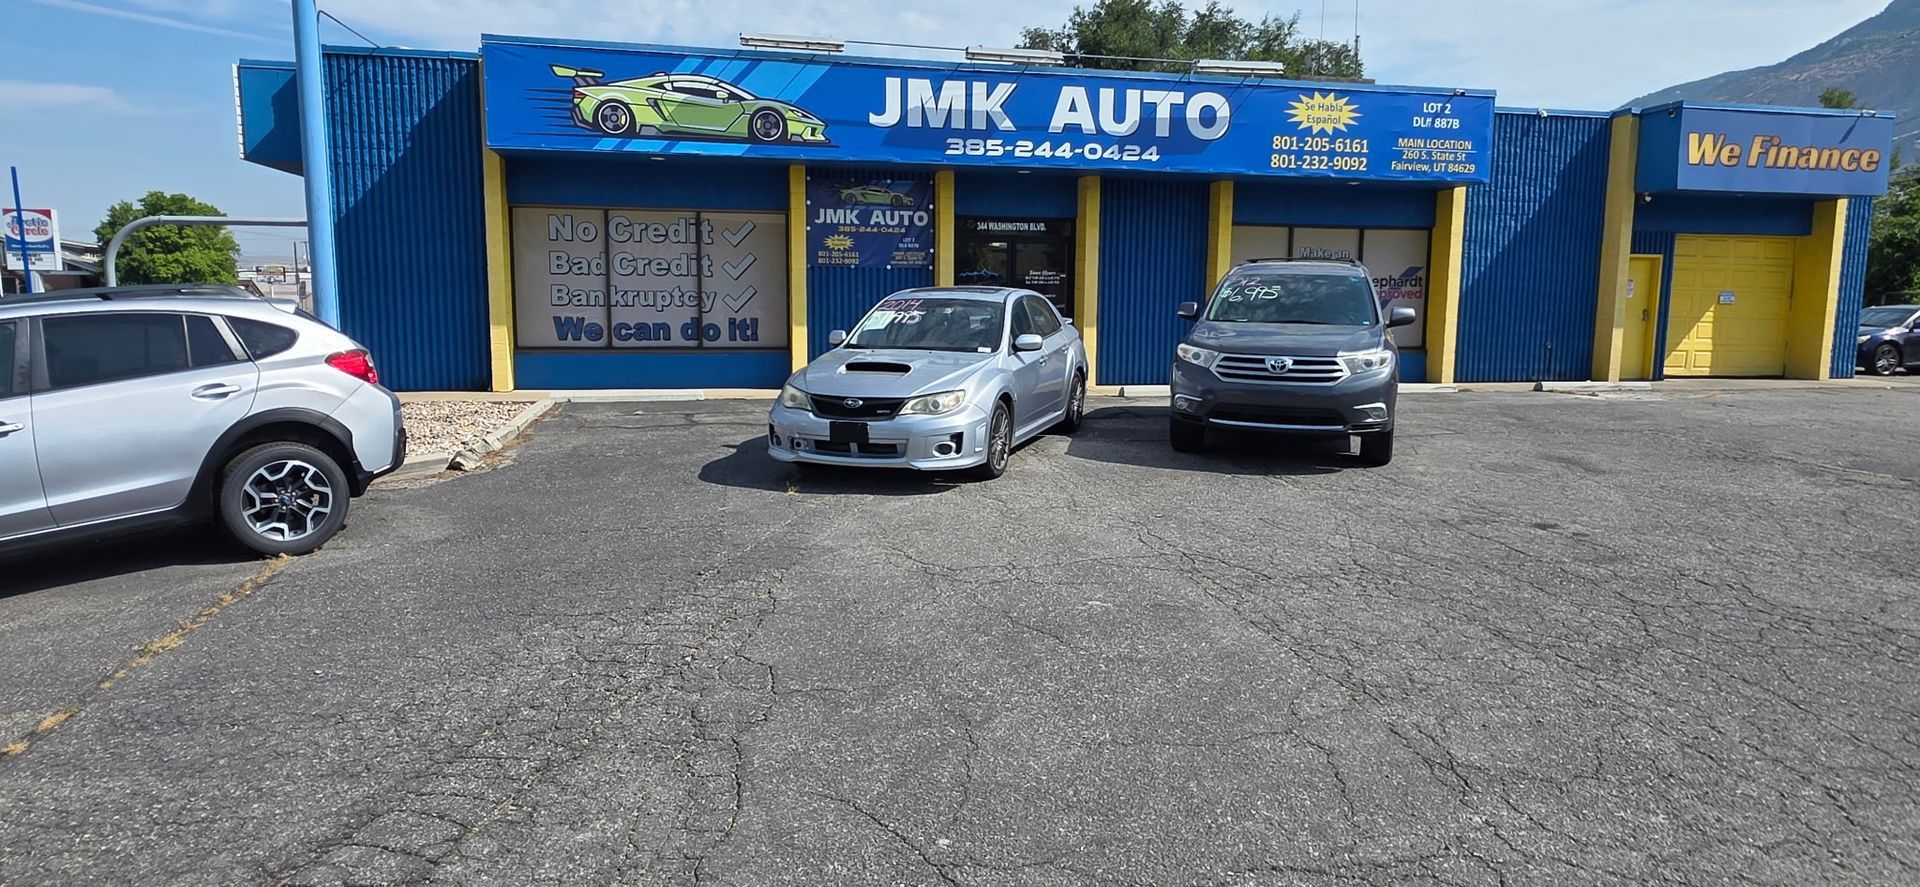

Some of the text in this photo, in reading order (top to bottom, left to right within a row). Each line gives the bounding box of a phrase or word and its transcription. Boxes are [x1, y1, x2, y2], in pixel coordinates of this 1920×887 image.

[869, 77, 1232, 141] JMK AUTO
[1305, 102, 1343, 113] Se Habla
[1423, 102, 1451, 115] LOT 2
[1306, 114, 1341, 126] Español
[1413, 116, 1460, 129] DL# 887B
[945, 137, 1160, 162] 385-244-0424
[1272, 135, 1369, 153] 801-205-6161
[1398, 138, 1472, 150] MAIN LOCATION
[1402, 150, 1466, 161] 260 S. State St
[1687, 132, 1881, 173] We Finance
[1270, 153, 1367, 171] 801-232-9092
[1391, 161, 1475, 173] Fairview, UT 84629
[815, 208, 929, 227] JMK AUTO
[11, 224, 49, 237] Crcle
[548, 214, 713, 245] No Credit
[977, 221, 1047, 231] 344 WASHINGTON BLVD.
[1300, 247, 1351, 259] Make an
[548, 251, 713, 277] Bad Credit
[1372, 275, 1424, 290] ephardt
[550, 284, 717, 313] Bankruptcy
[1376, 288, 1423, 300] proved
[878, 299, 924, 310] 2014
[553, 316, 759, 342] We can do it!
